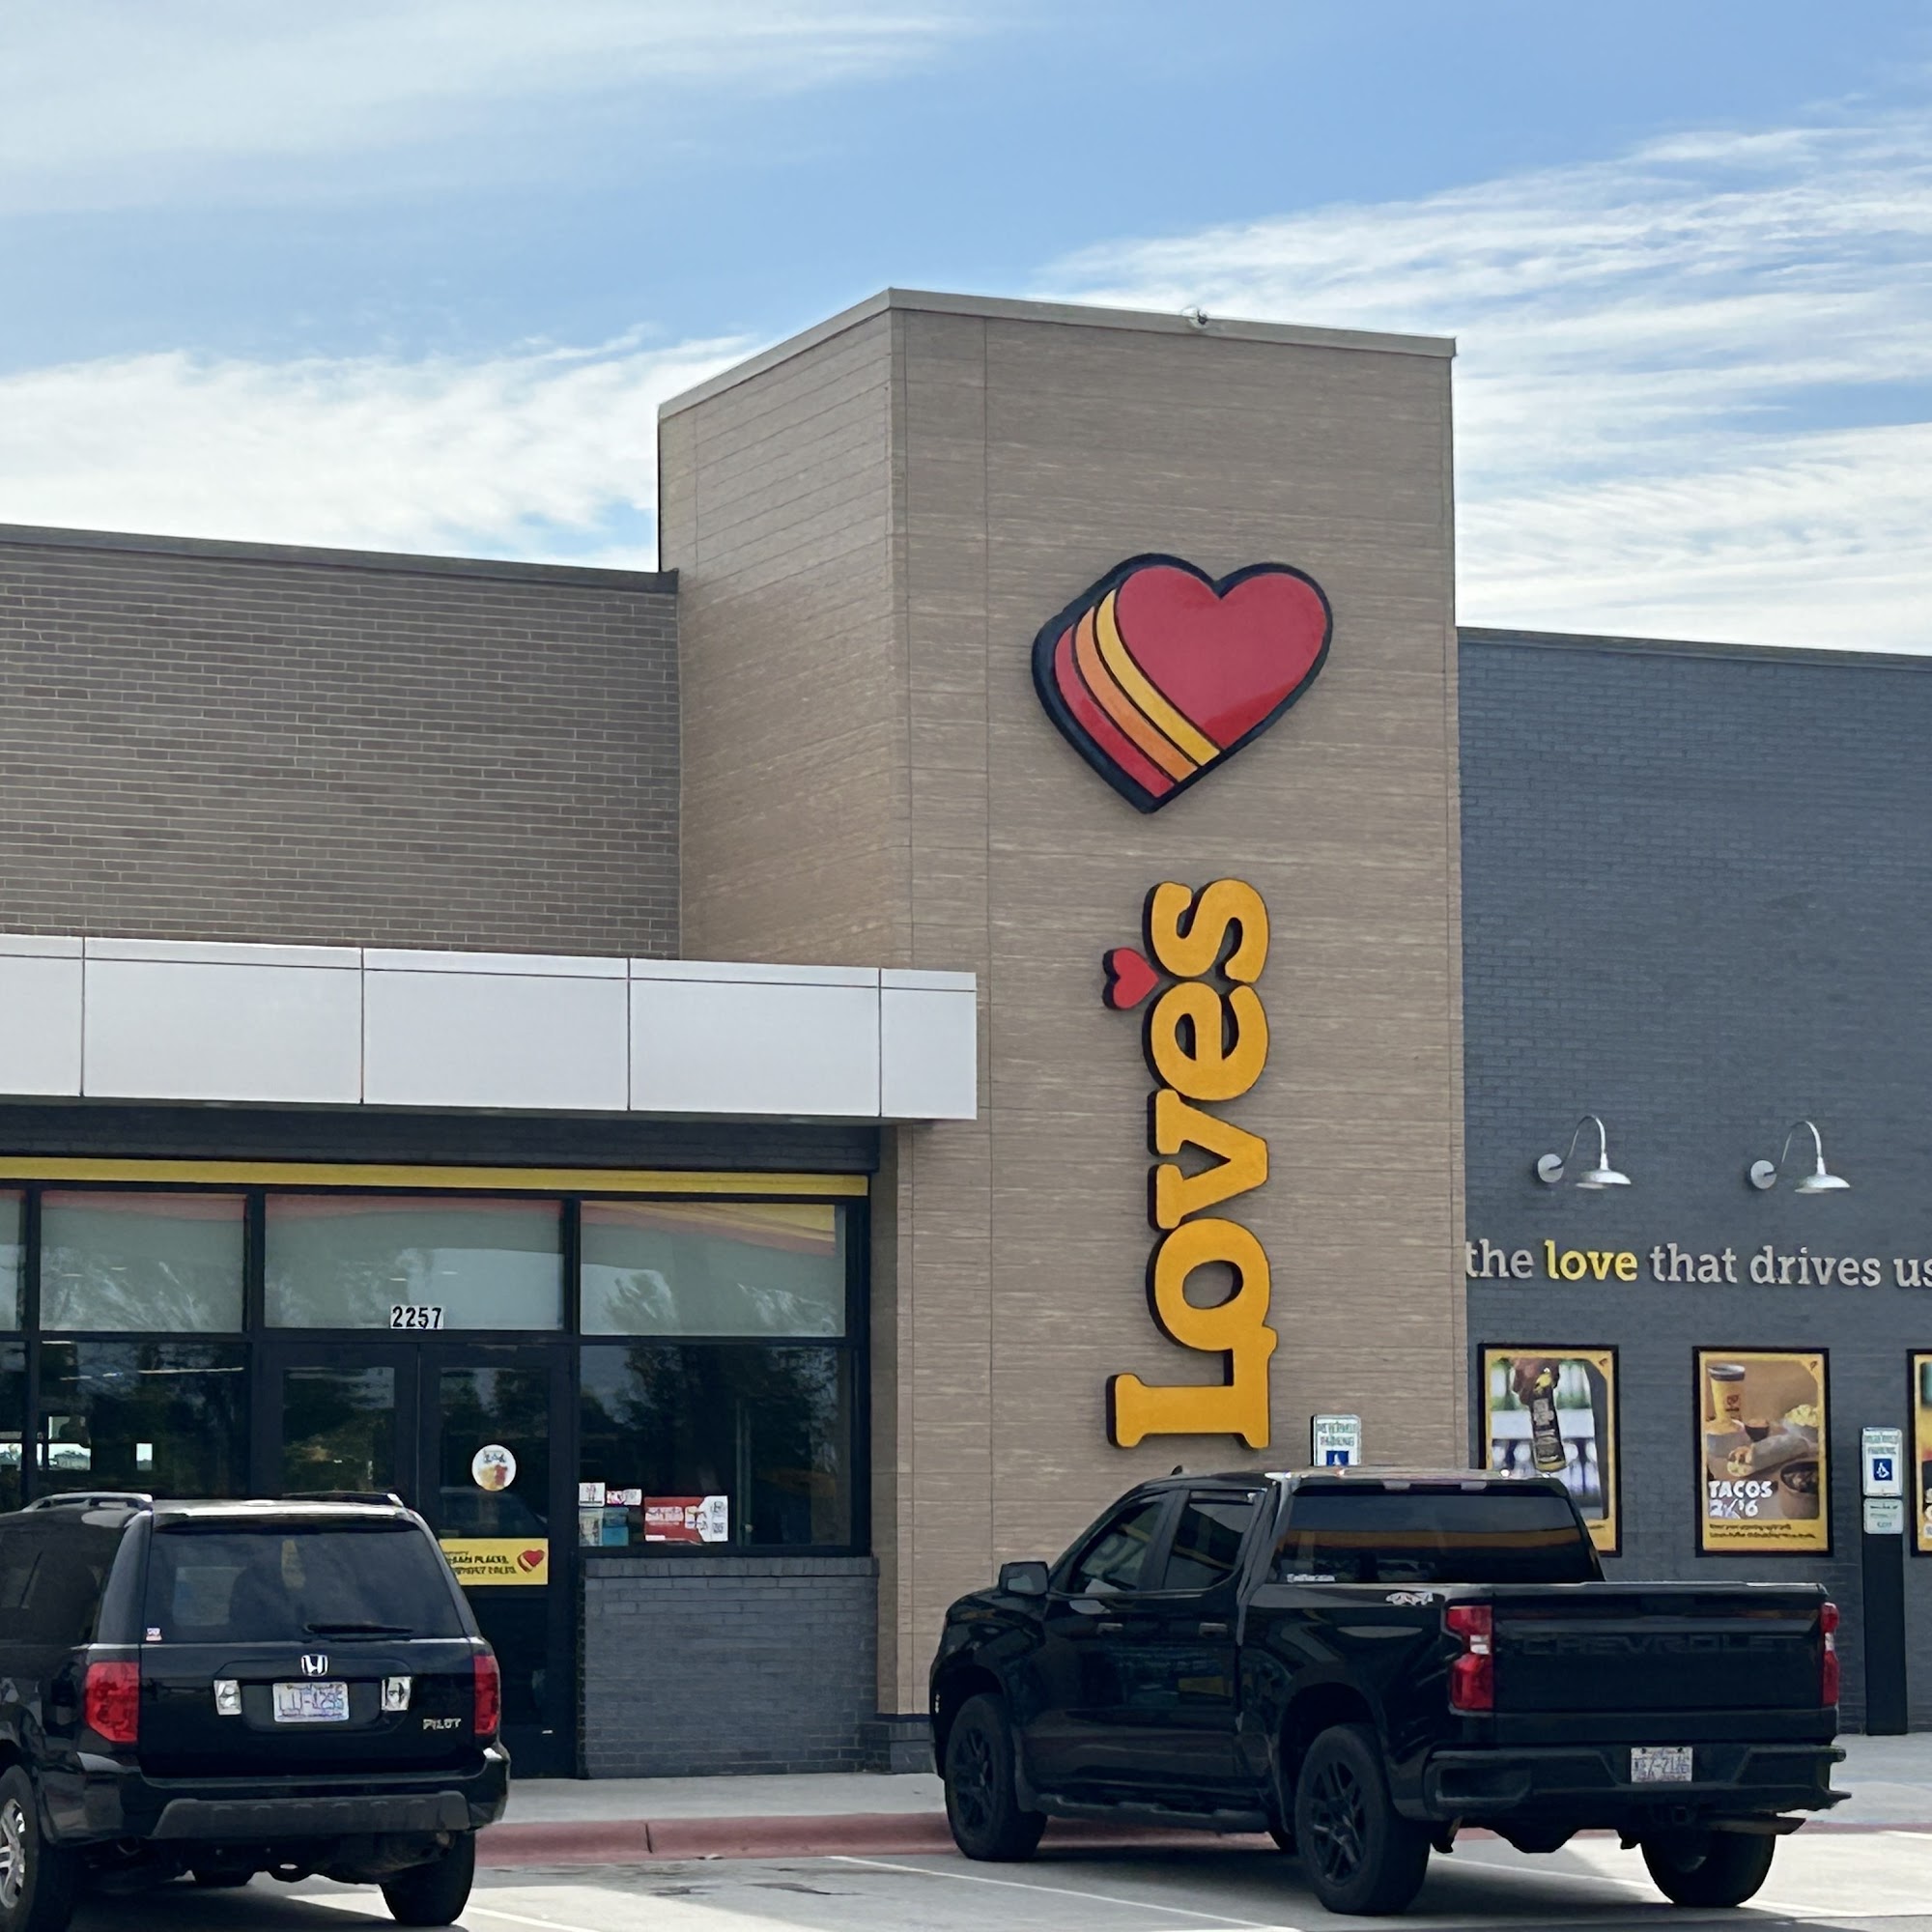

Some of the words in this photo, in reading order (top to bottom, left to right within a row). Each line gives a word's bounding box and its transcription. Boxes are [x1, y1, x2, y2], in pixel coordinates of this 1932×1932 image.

[1465, 1238, 1534, 1279] the
[1545, 1239, 1638, 1282] love
[1649, 1243, 1738, 1284] that
[1749, 1245, 1882, 1288] drives
[1893, 1258, 1932, 1288] us
[391, 1305, 443, 1329] 2257
[1708, 1480, 1774, 1498] TACOS
[422, 1718, 462, 1730] PILOT
